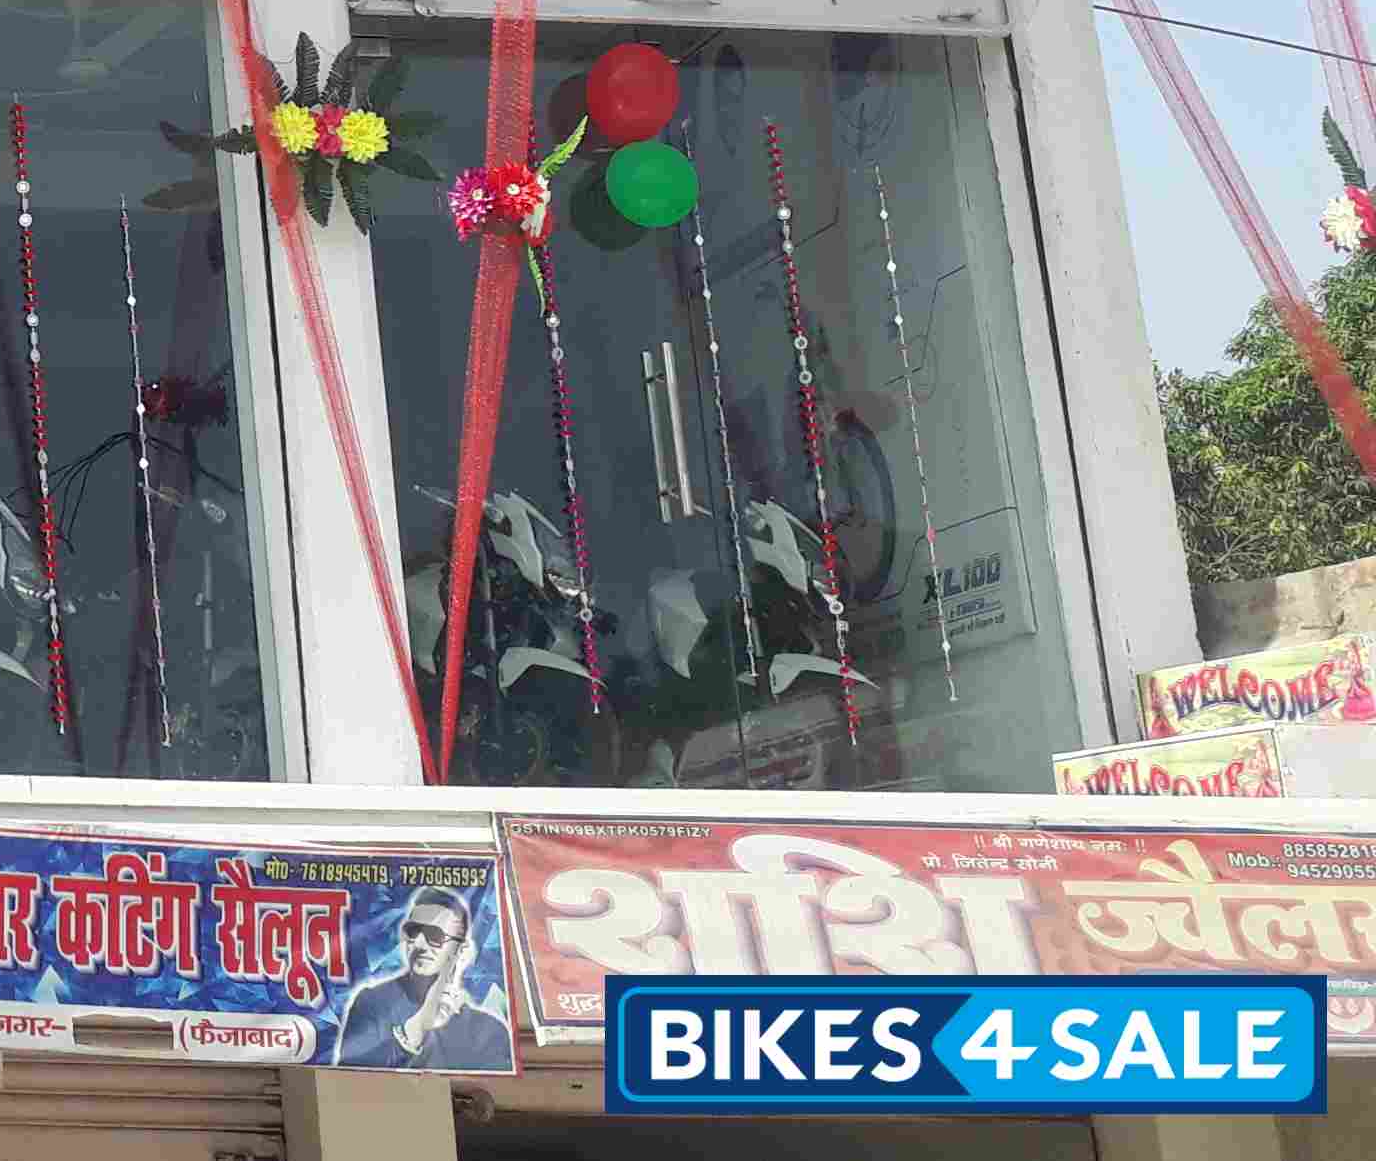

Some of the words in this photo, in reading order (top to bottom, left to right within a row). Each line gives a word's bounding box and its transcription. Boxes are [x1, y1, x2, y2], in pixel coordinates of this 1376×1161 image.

[1167, 661, 1340, 721] WELCOME
[51, 852, 198, 975] कटिंग
[211, 858, 350, 1004] सैलून
